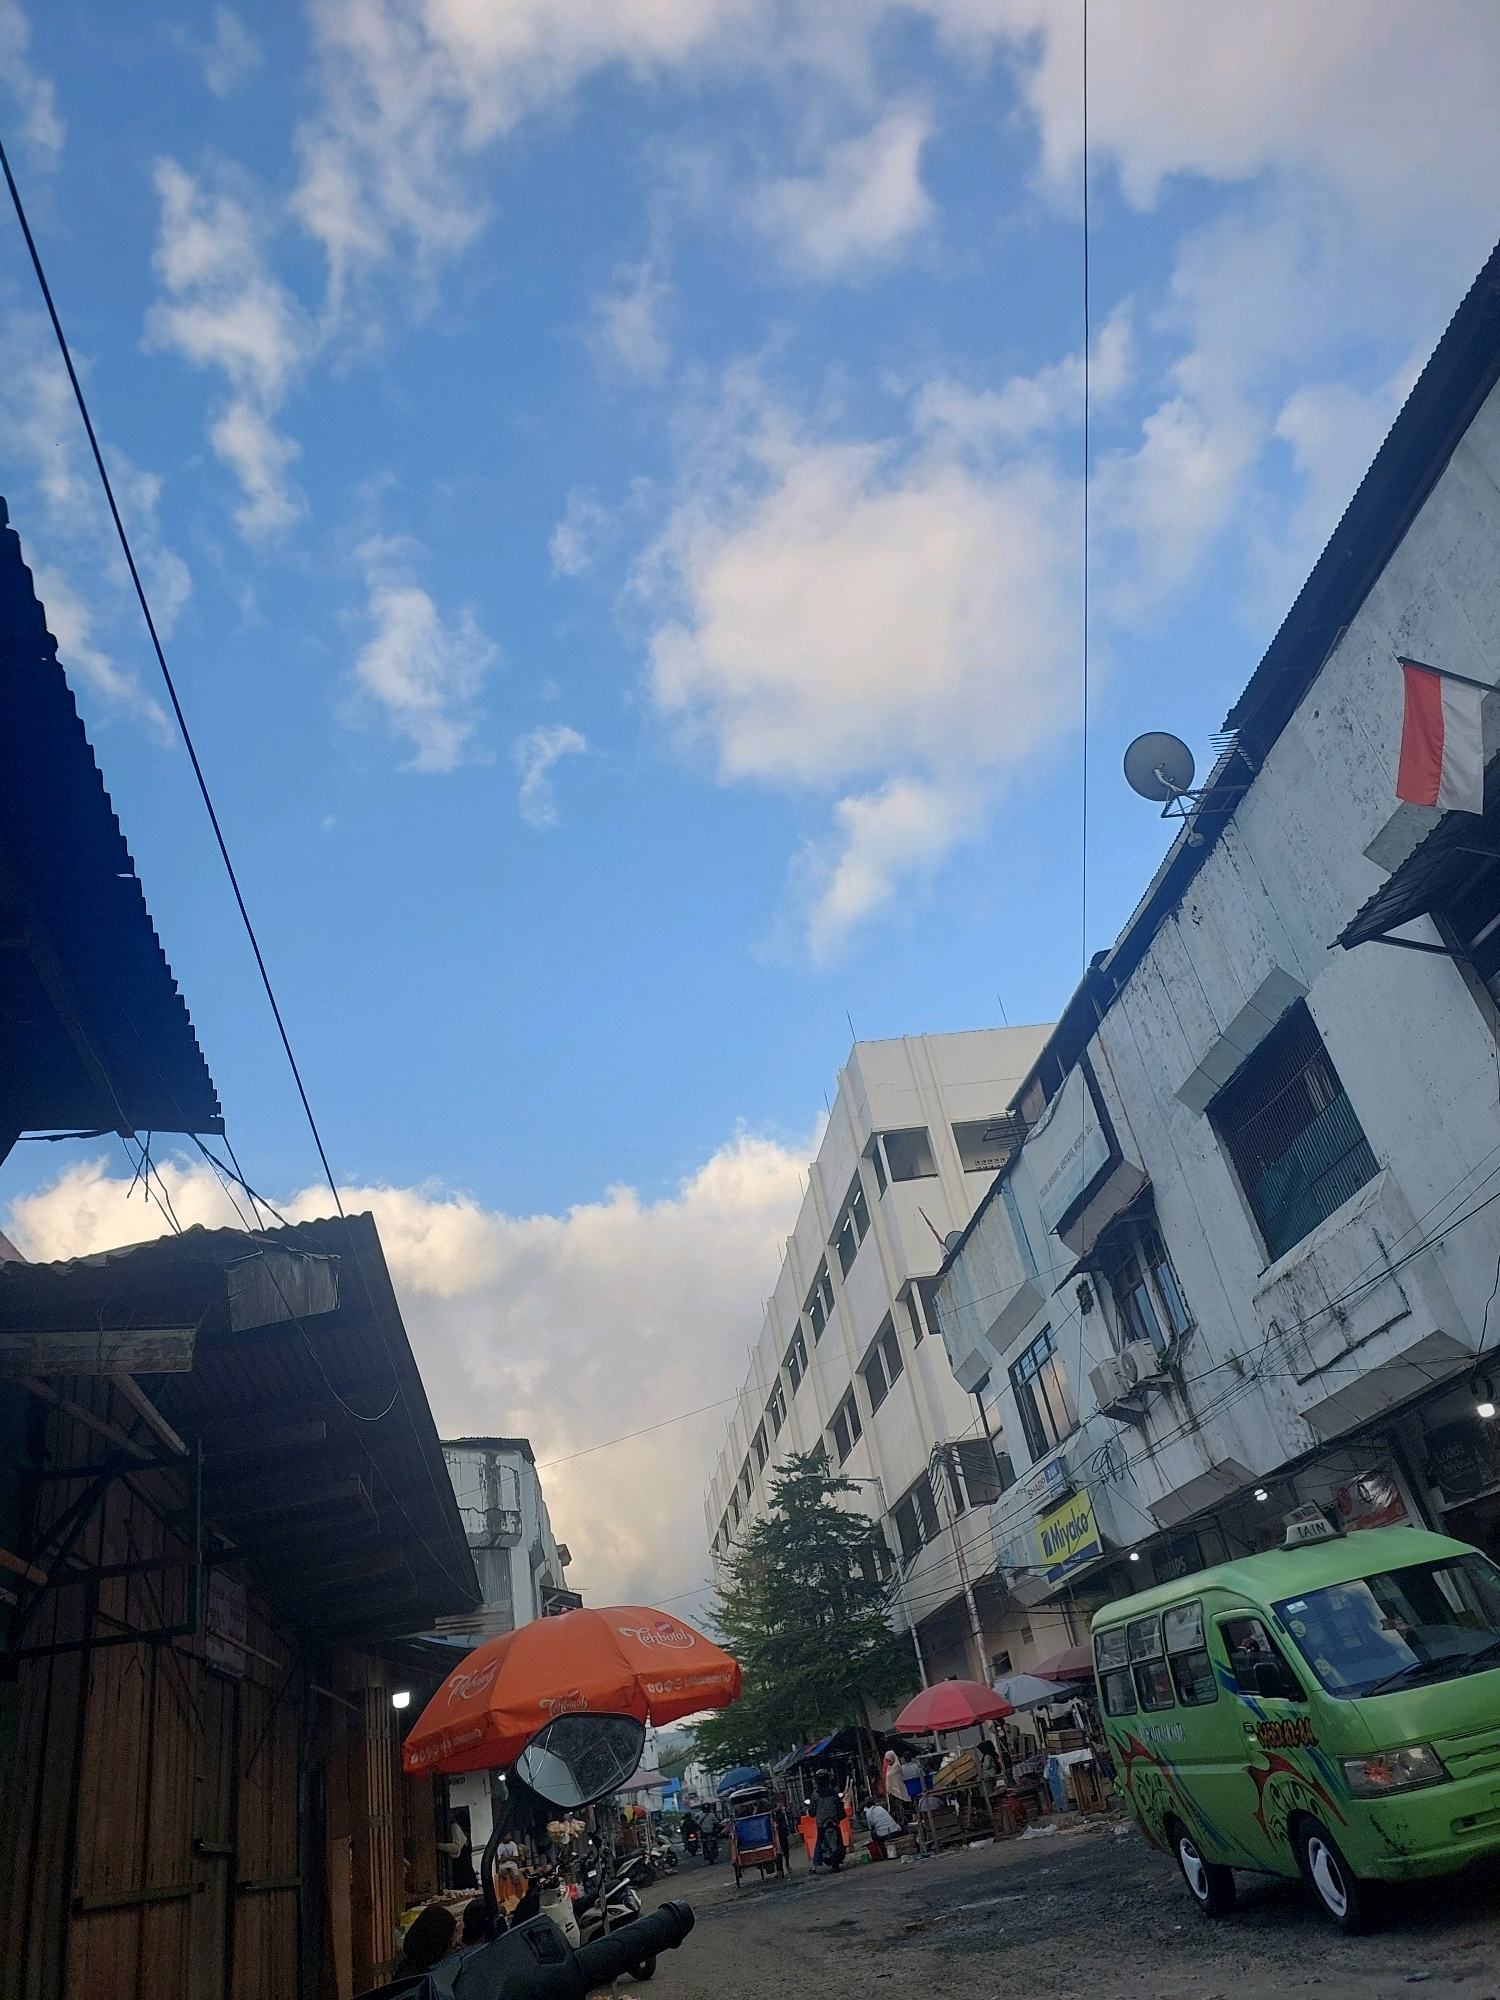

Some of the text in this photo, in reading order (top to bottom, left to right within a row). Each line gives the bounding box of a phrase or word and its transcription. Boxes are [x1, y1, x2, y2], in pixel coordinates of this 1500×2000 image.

[1027, 1477, 1046, 1499] SHARP
[1049, 1508, 1089, 1554] Miyako
[1297, 1521, 1327, 1539] IAIN
